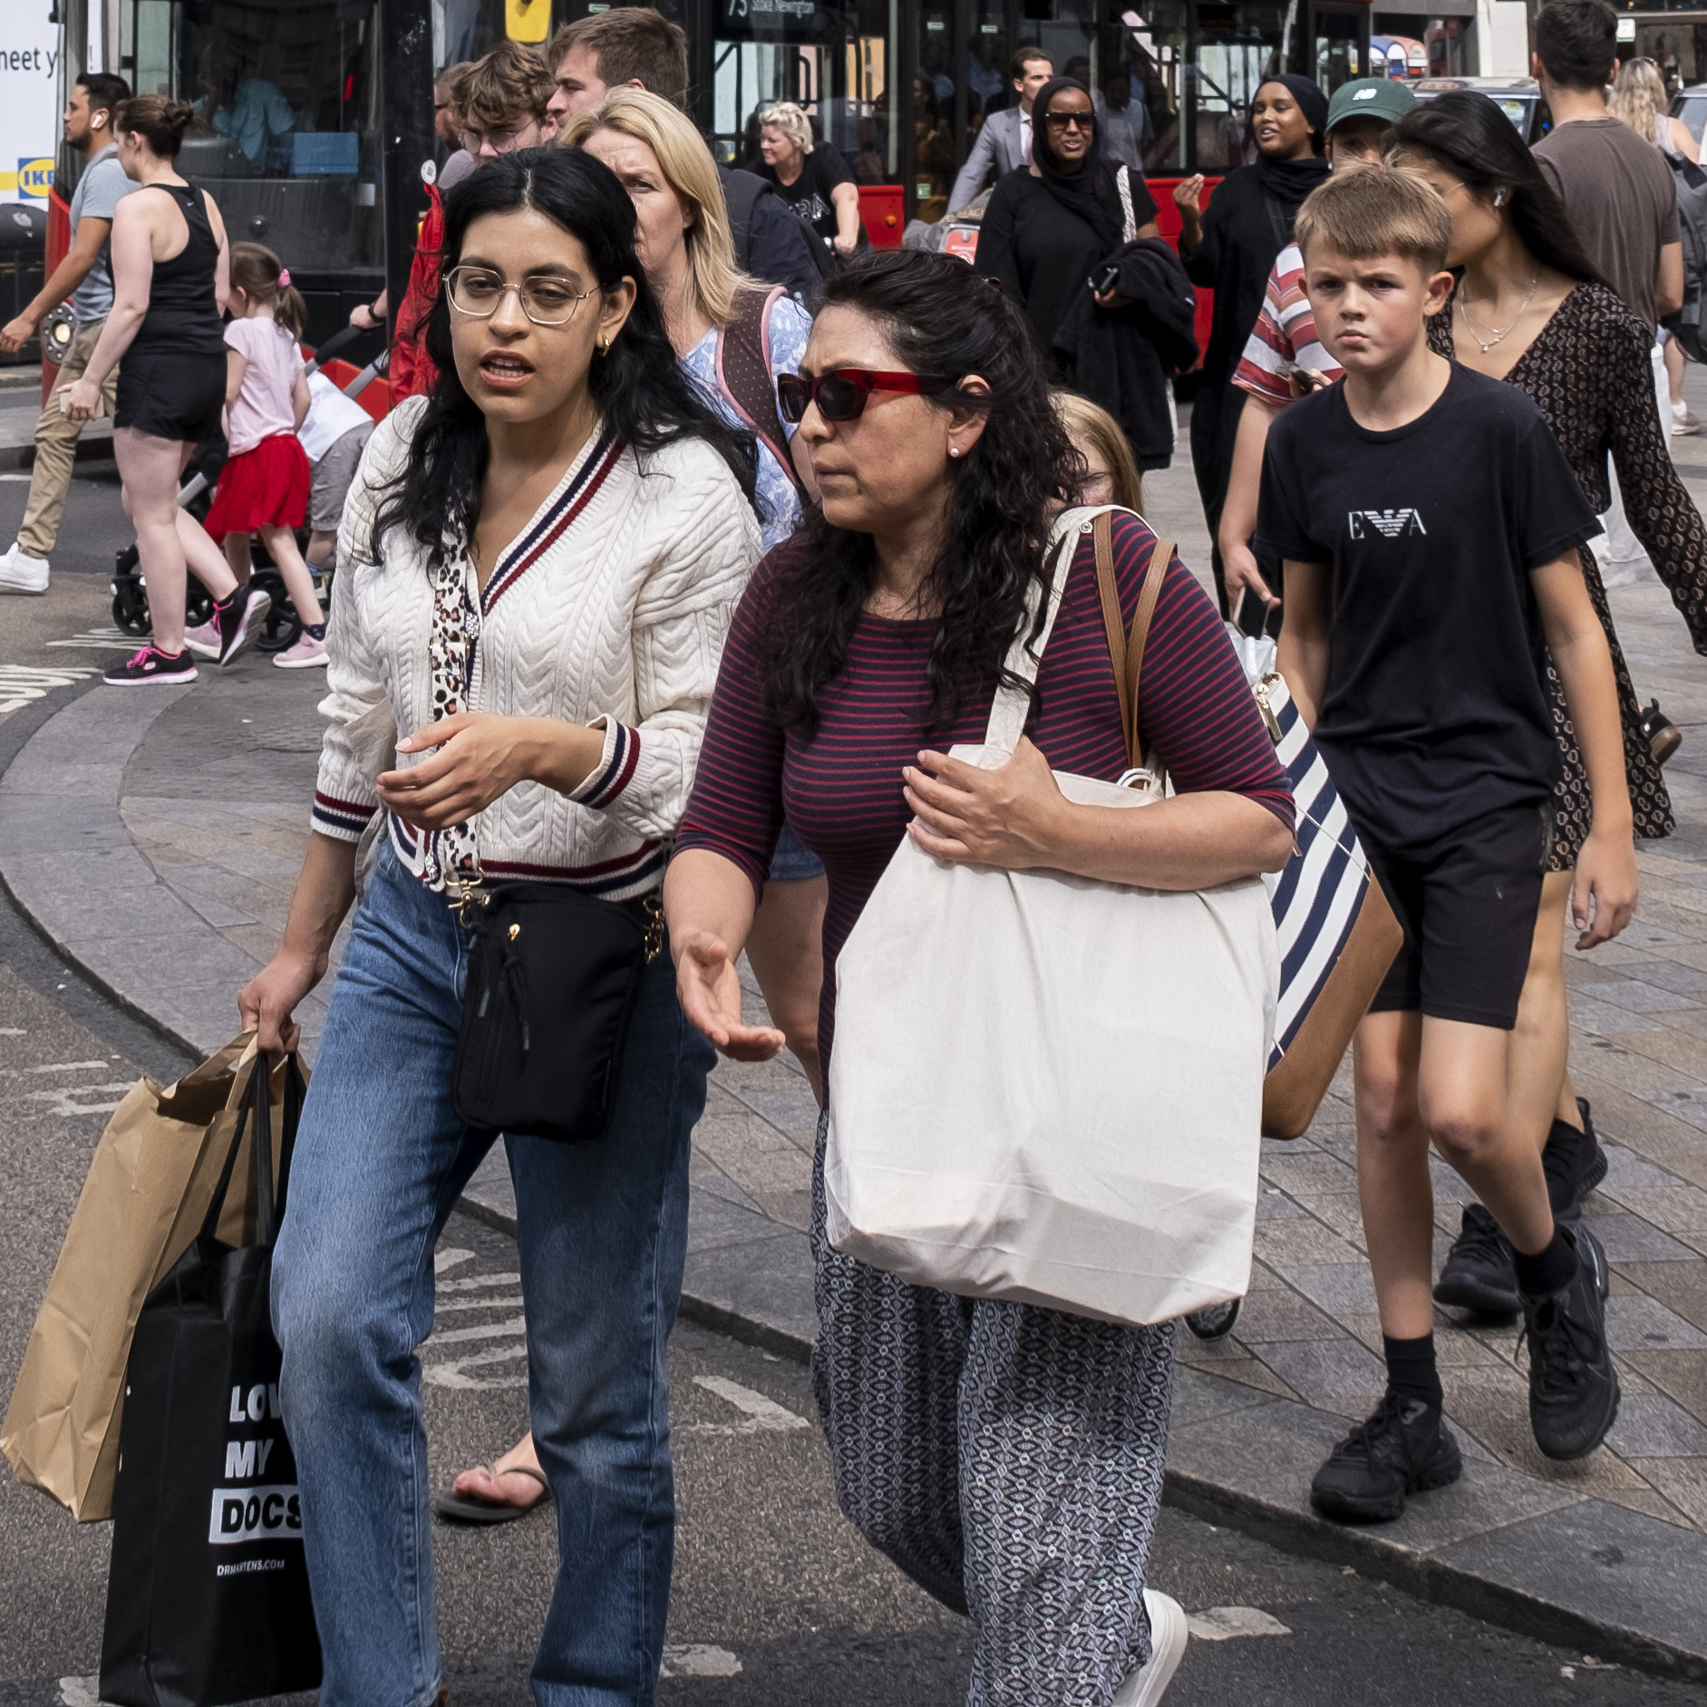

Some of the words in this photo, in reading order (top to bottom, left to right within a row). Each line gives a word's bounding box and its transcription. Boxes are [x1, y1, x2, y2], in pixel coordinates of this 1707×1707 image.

[23, 170, 55, 187] IKE
[224, 1437, 275, 1480] MY
[220, 1492, 303, 1535] DOCS
[216, 1558, 286, 1577] DRMARTENS.COM
